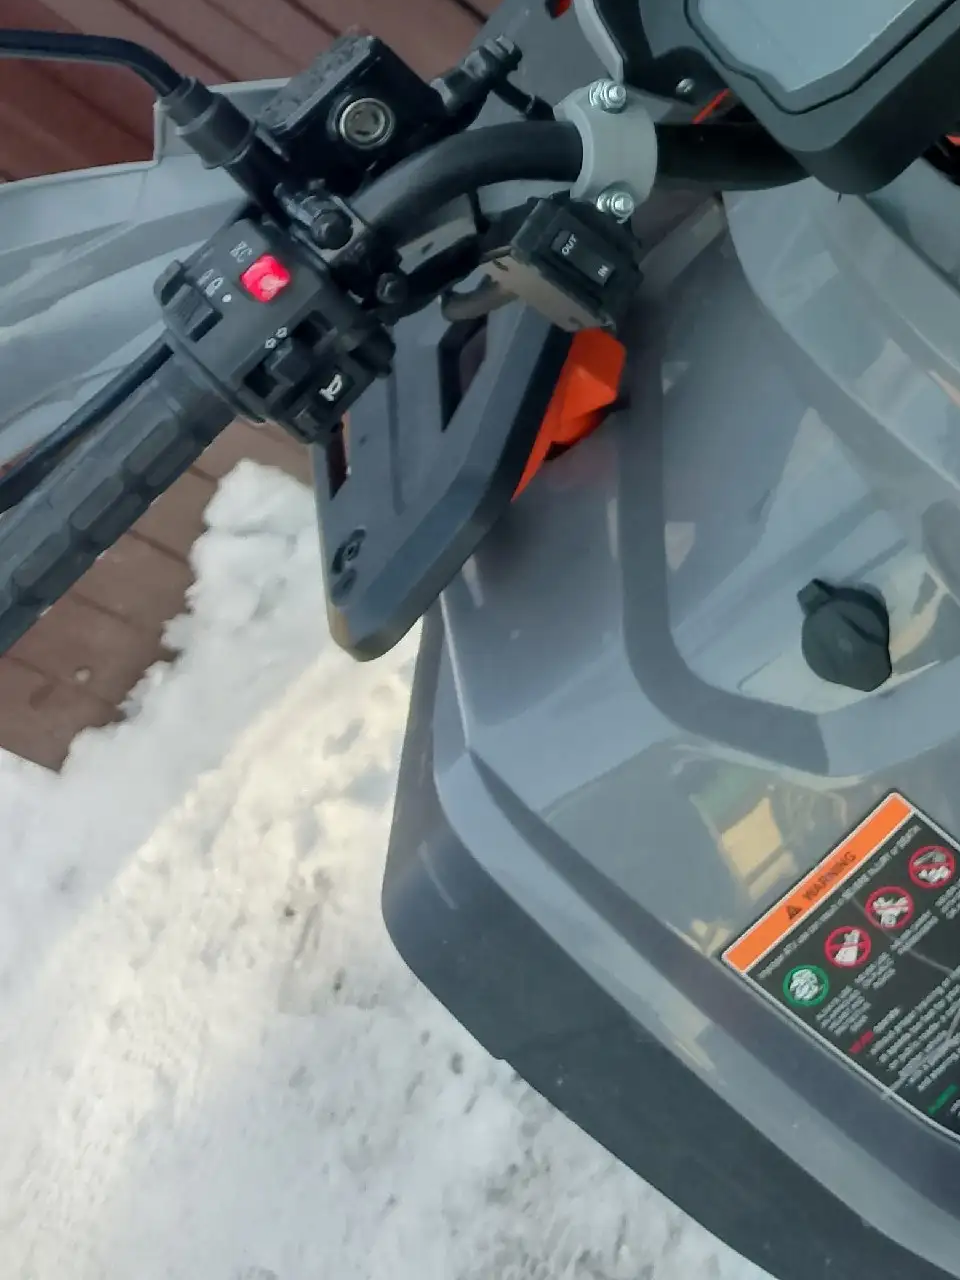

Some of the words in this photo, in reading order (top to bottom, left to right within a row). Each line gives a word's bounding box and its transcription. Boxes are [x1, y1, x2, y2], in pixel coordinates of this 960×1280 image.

[561, 233, 577, 256] OUT
[597, 264, 608, 277] IN
[803, 851, 856, 901] WARNING
